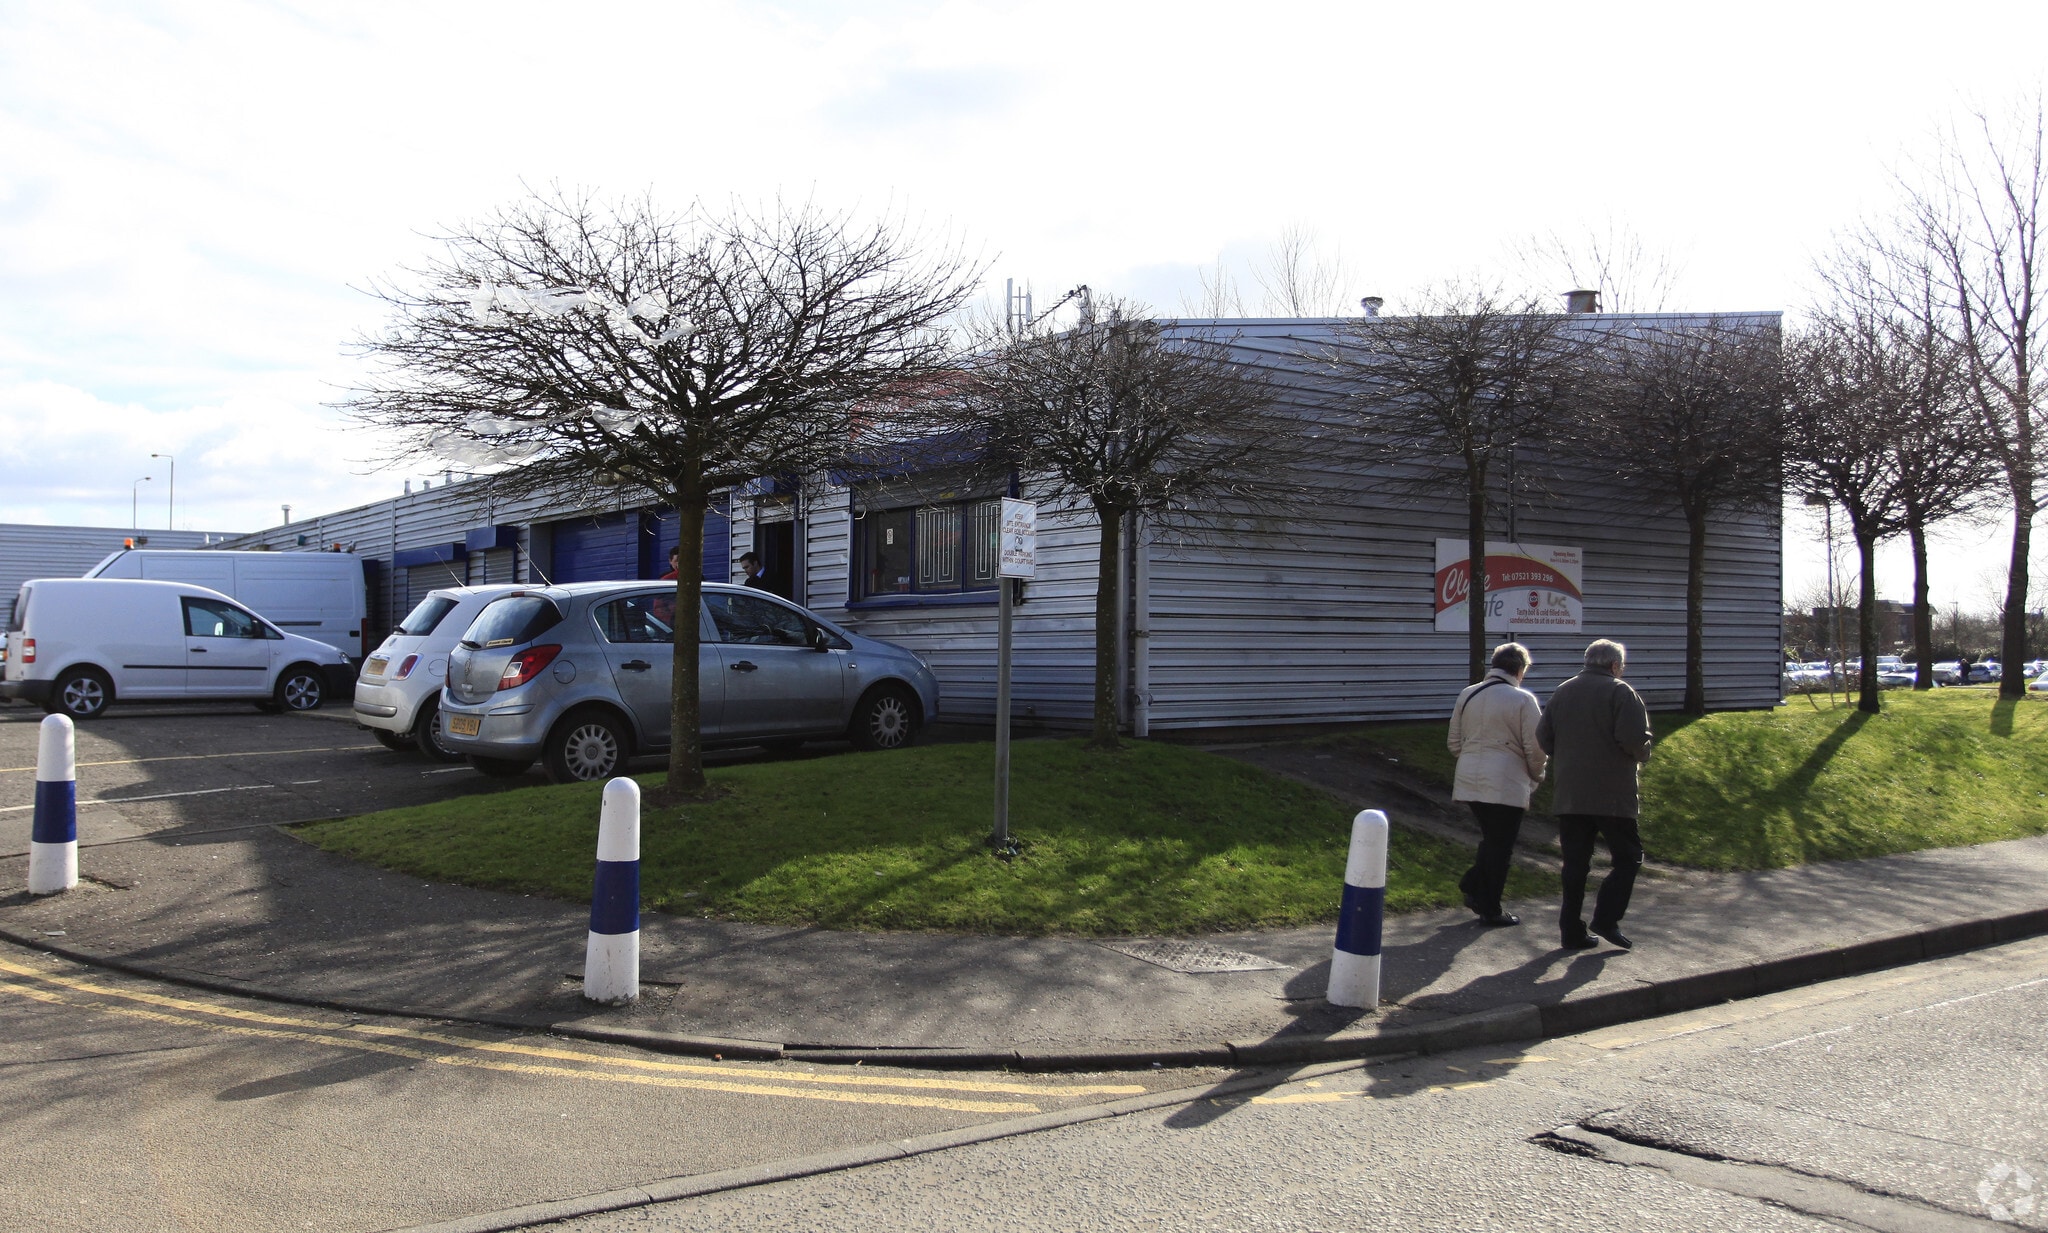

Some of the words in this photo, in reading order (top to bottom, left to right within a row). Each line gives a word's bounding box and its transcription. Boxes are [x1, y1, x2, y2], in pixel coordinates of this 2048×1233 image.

[1511, 572, 1530, 581] 07521
[1530, 572, 1541, 581] 393
[1542, 573, 1553, 583] 296
[1442, 568, 1491, 603] Clye
[1540, 608, 1549, 616] cold
